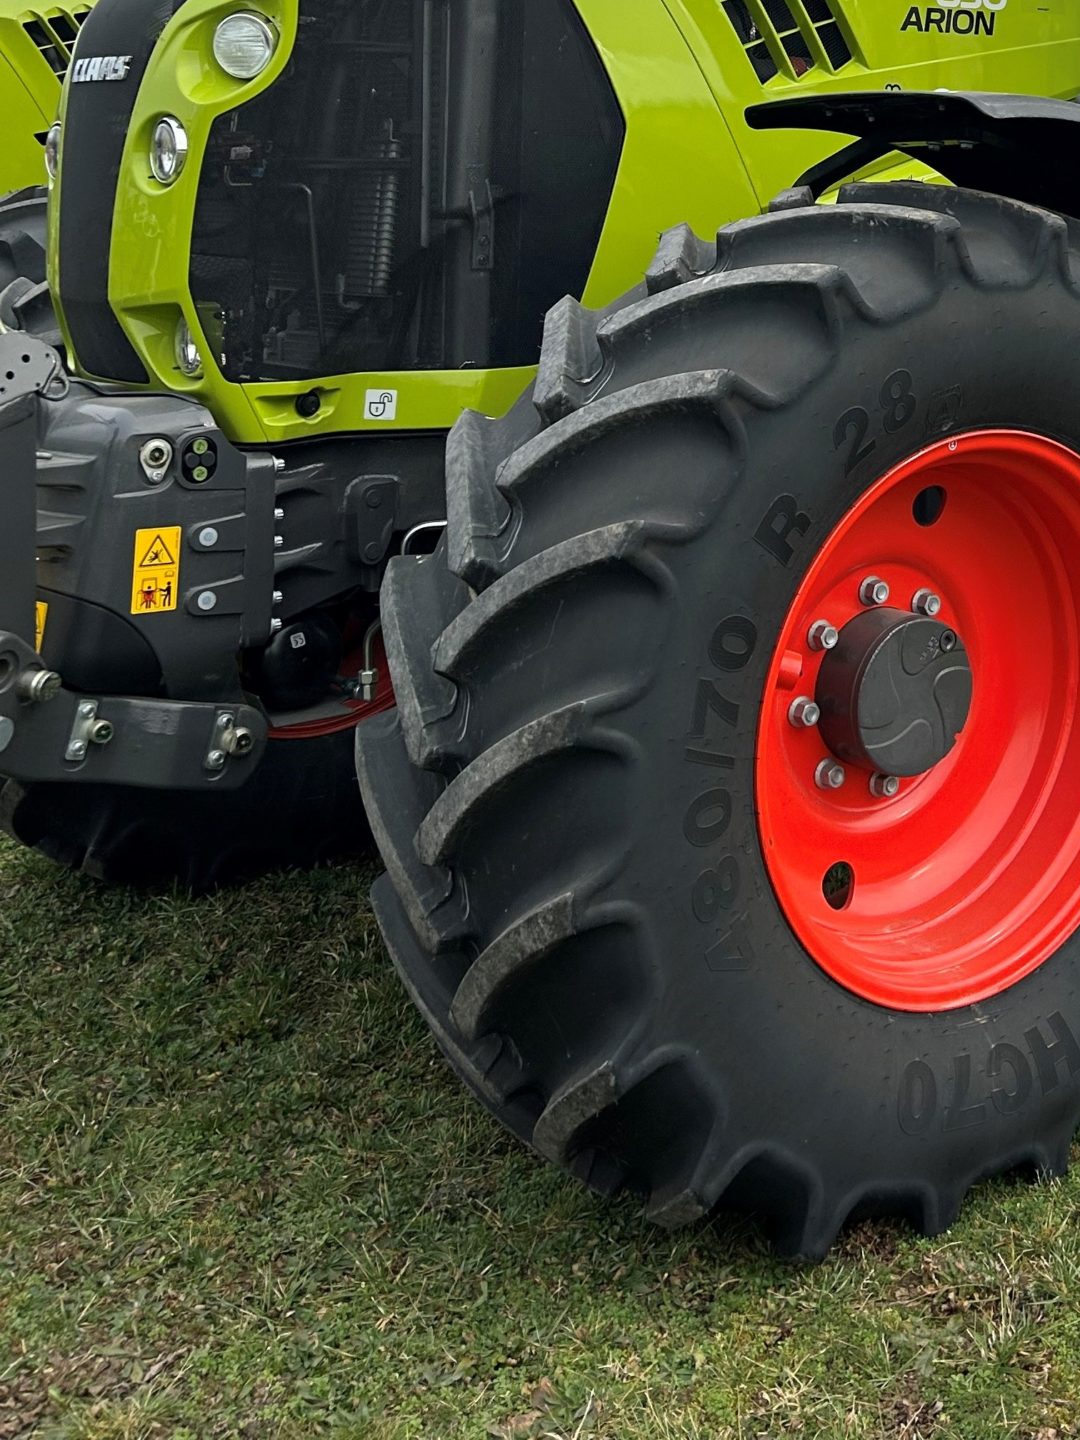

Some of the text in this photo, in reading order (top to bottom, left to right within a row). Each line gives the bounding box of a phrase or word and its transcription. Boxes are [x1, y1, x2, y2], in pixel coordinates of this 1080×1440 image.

[900, 6, 996, 36] ARION
[72, 55, 133, 83] CLAAS
[683, 368, 917, 973] 480/70 R 28
